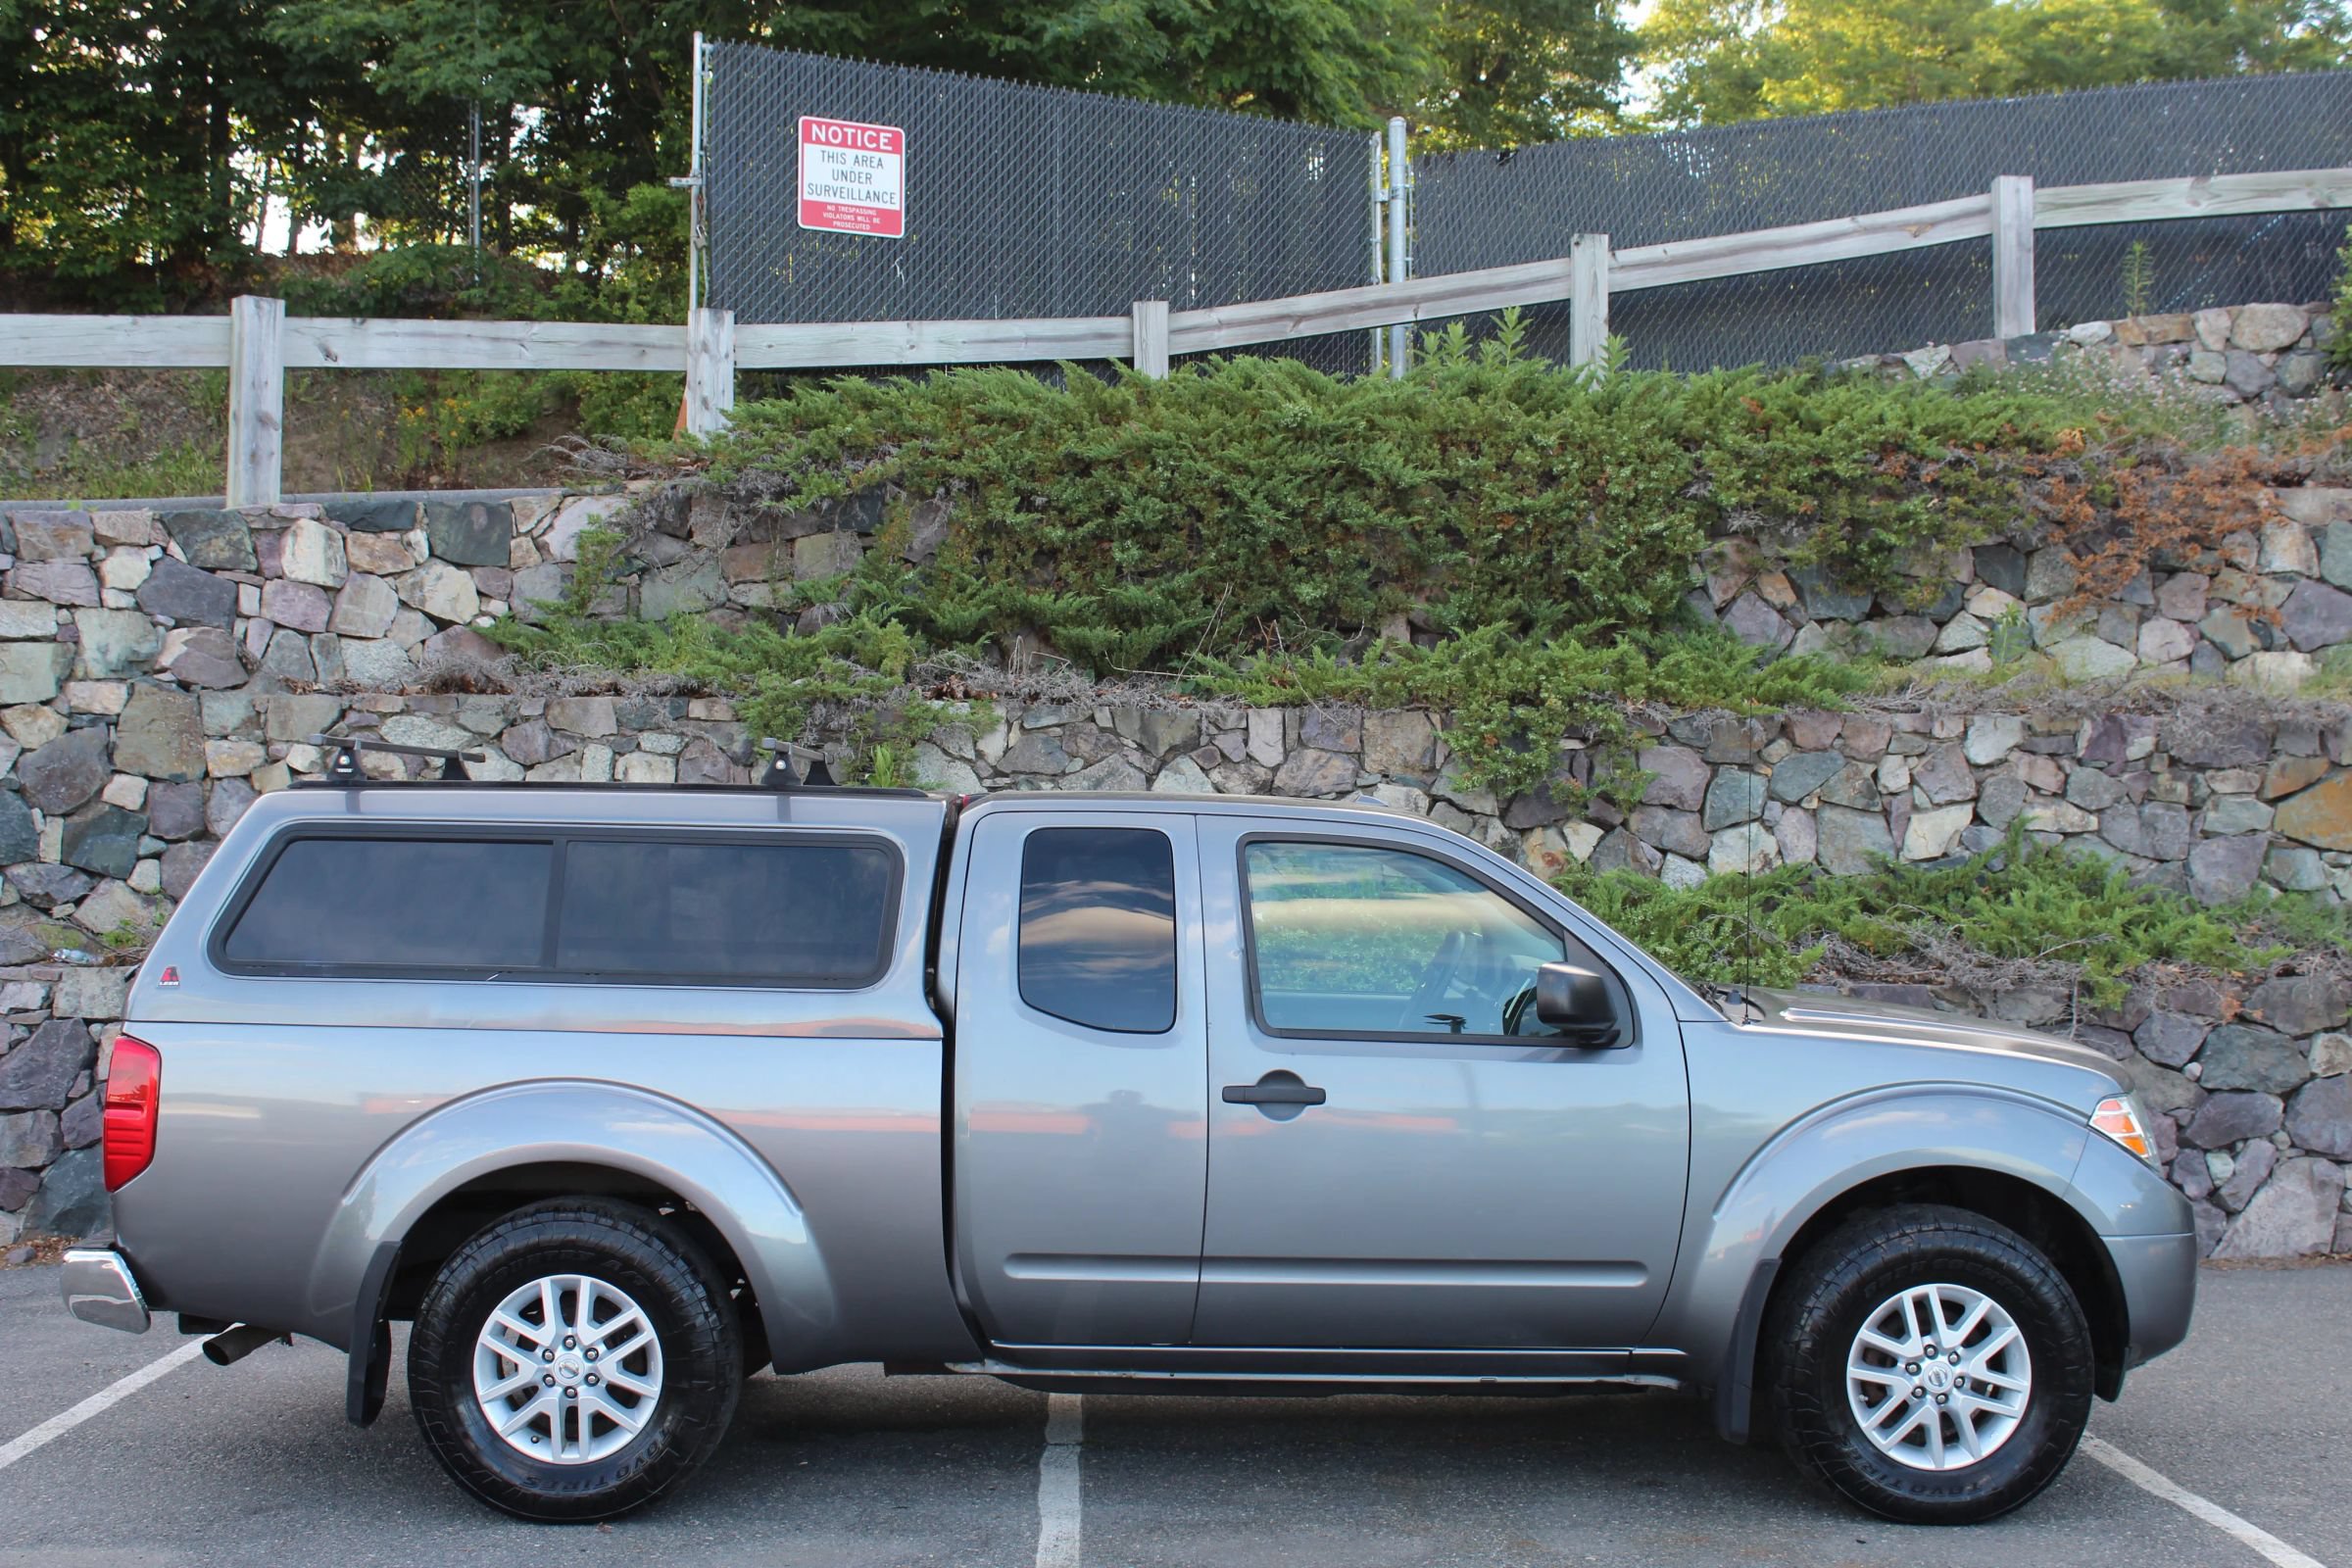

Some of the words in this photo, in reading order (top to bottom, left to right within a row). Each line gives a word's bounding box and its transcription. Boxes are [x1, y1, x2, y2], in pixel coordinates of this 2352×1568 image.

[811, 123, 893, 151] NOTICE
[821, 150, 847, 165] THIS
[853, 154, 884, 170] AREA
[832, 169, 872, 185] UNDER
[808, 182, 897, 205] SURVEILLANCE
[822, 212, 856, 221] VIOLATORS
[838, 206, 877, 216] TRESPASSING
[833, 220, 871, 230] PROSECUTED
[610, 1424, 674, 1484] TOYO
